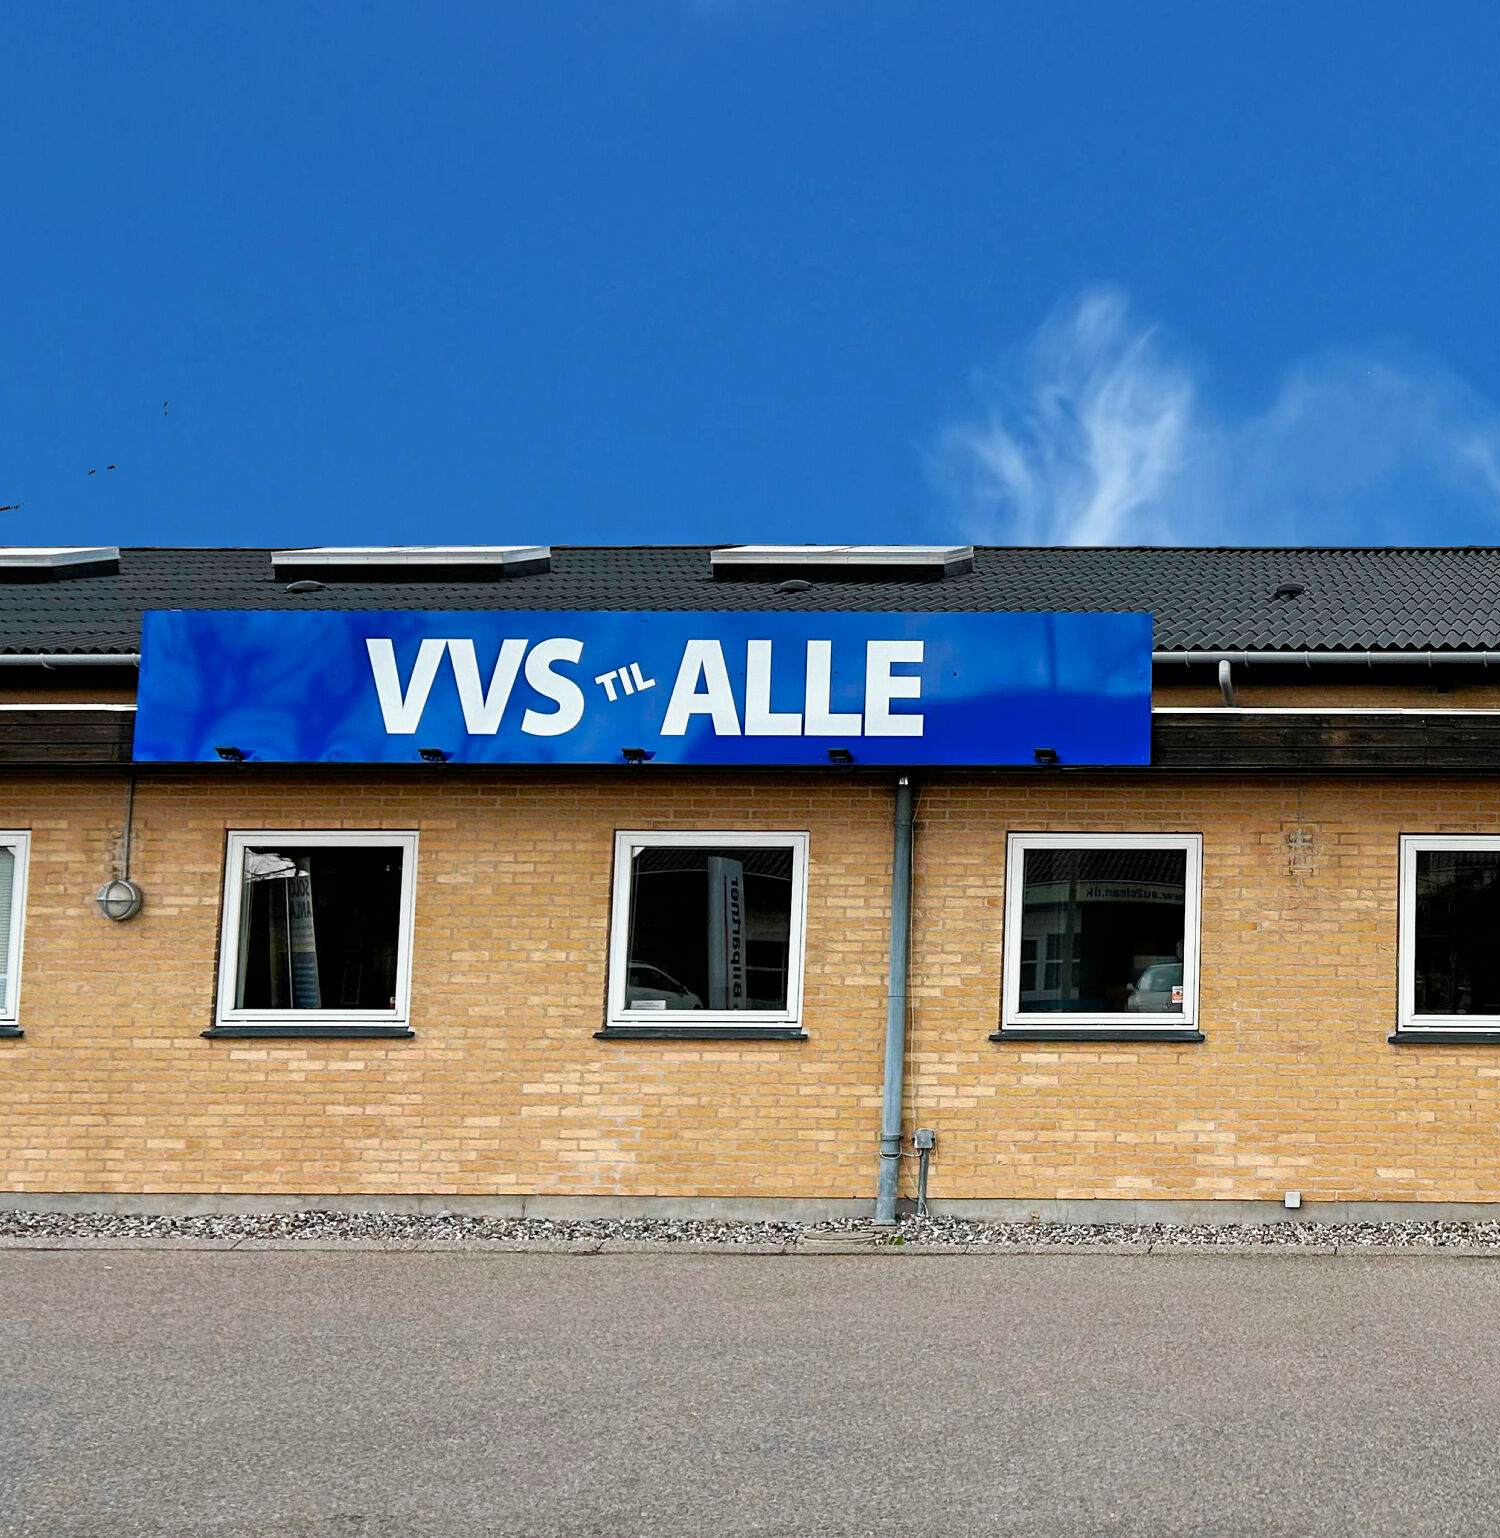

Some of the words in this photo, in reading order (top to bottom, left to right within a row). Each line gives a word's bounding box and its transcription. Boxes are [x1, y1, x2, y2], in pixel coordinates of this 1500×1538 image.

[365, 638, 585, 736] VVS
[594, 662, 656, 702] TIL
[660, 639, 924, 737] ALLE
